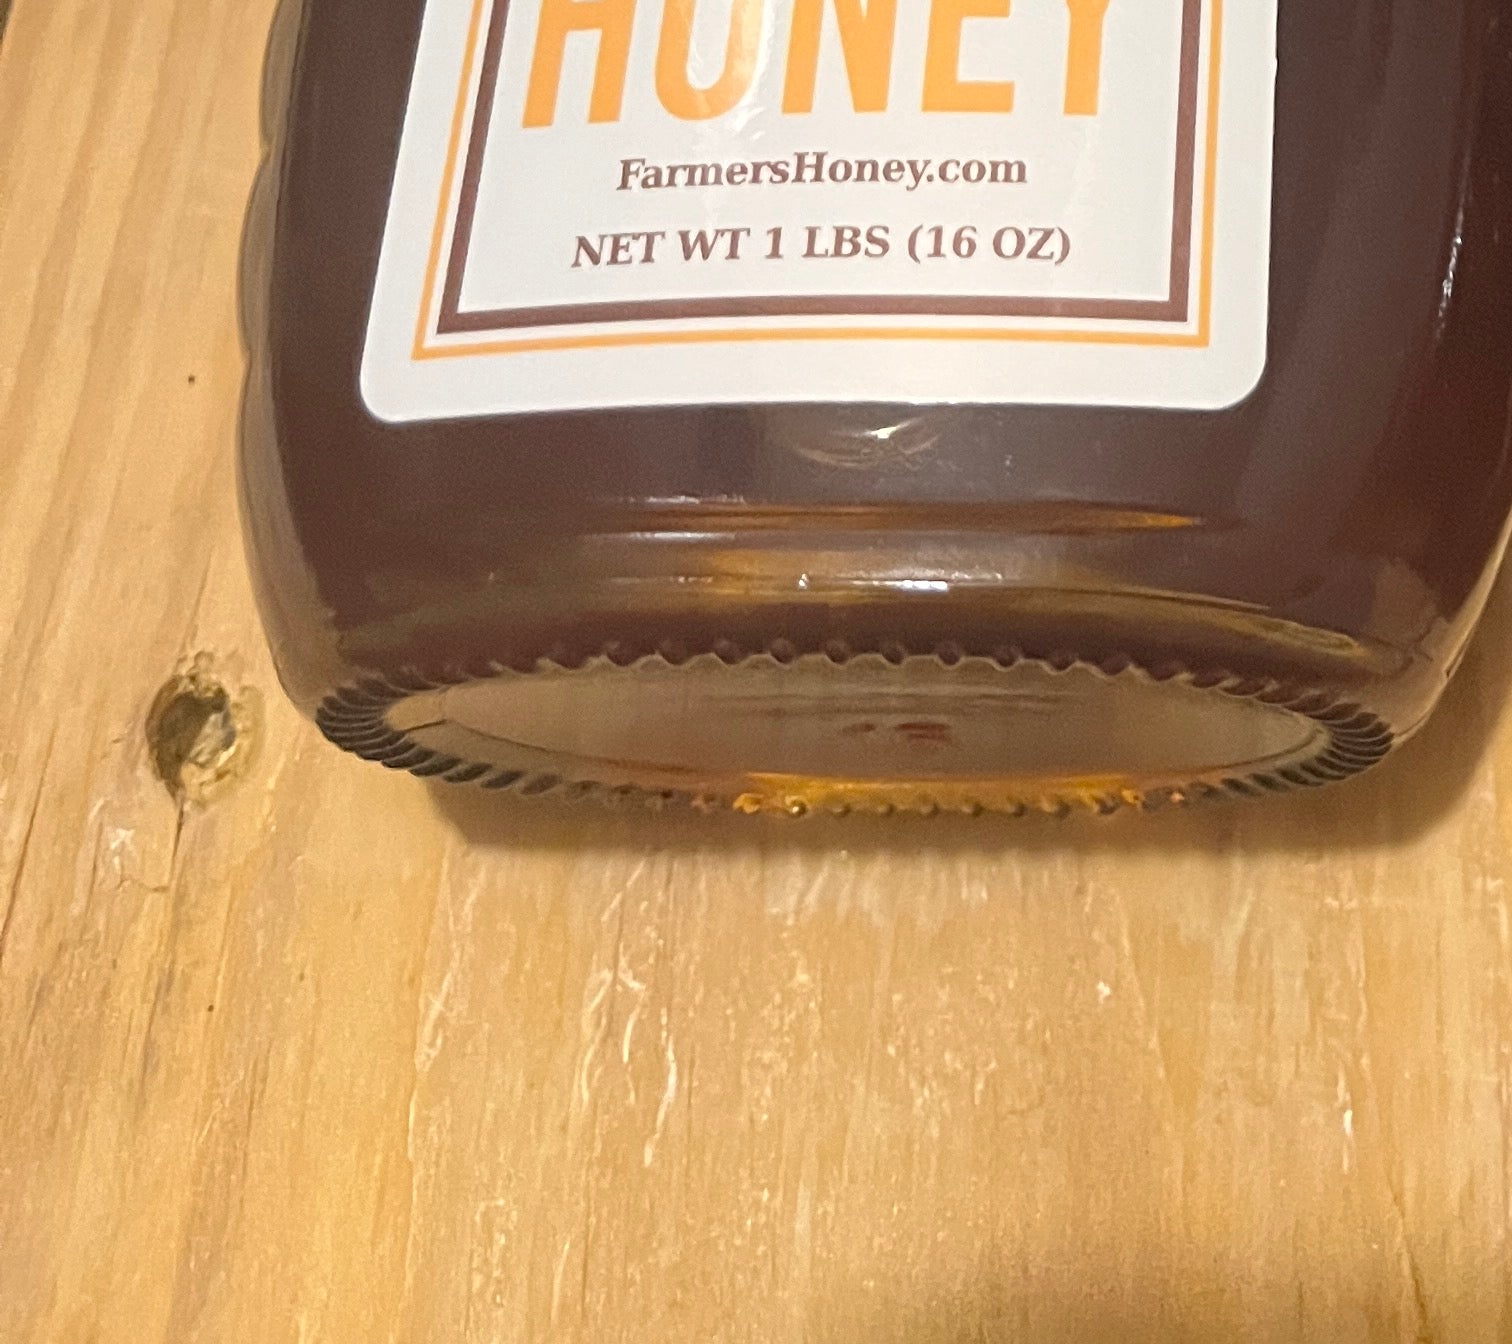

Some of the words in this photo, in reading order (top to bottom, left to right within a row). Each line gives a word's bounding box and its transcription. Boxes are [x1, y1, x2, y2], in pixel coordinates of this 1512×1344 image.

[616, 152, 1027, 191] FarmersHoney.com
[571, 231, 665, 268] NET
[678, 228, 750, 261] WT
[765, 227, 783, 259] 1
[802, 225, 889, 258] LBS
[908, 224, 977, 264] (16
[993, 227, 1070, 265] OZ)
